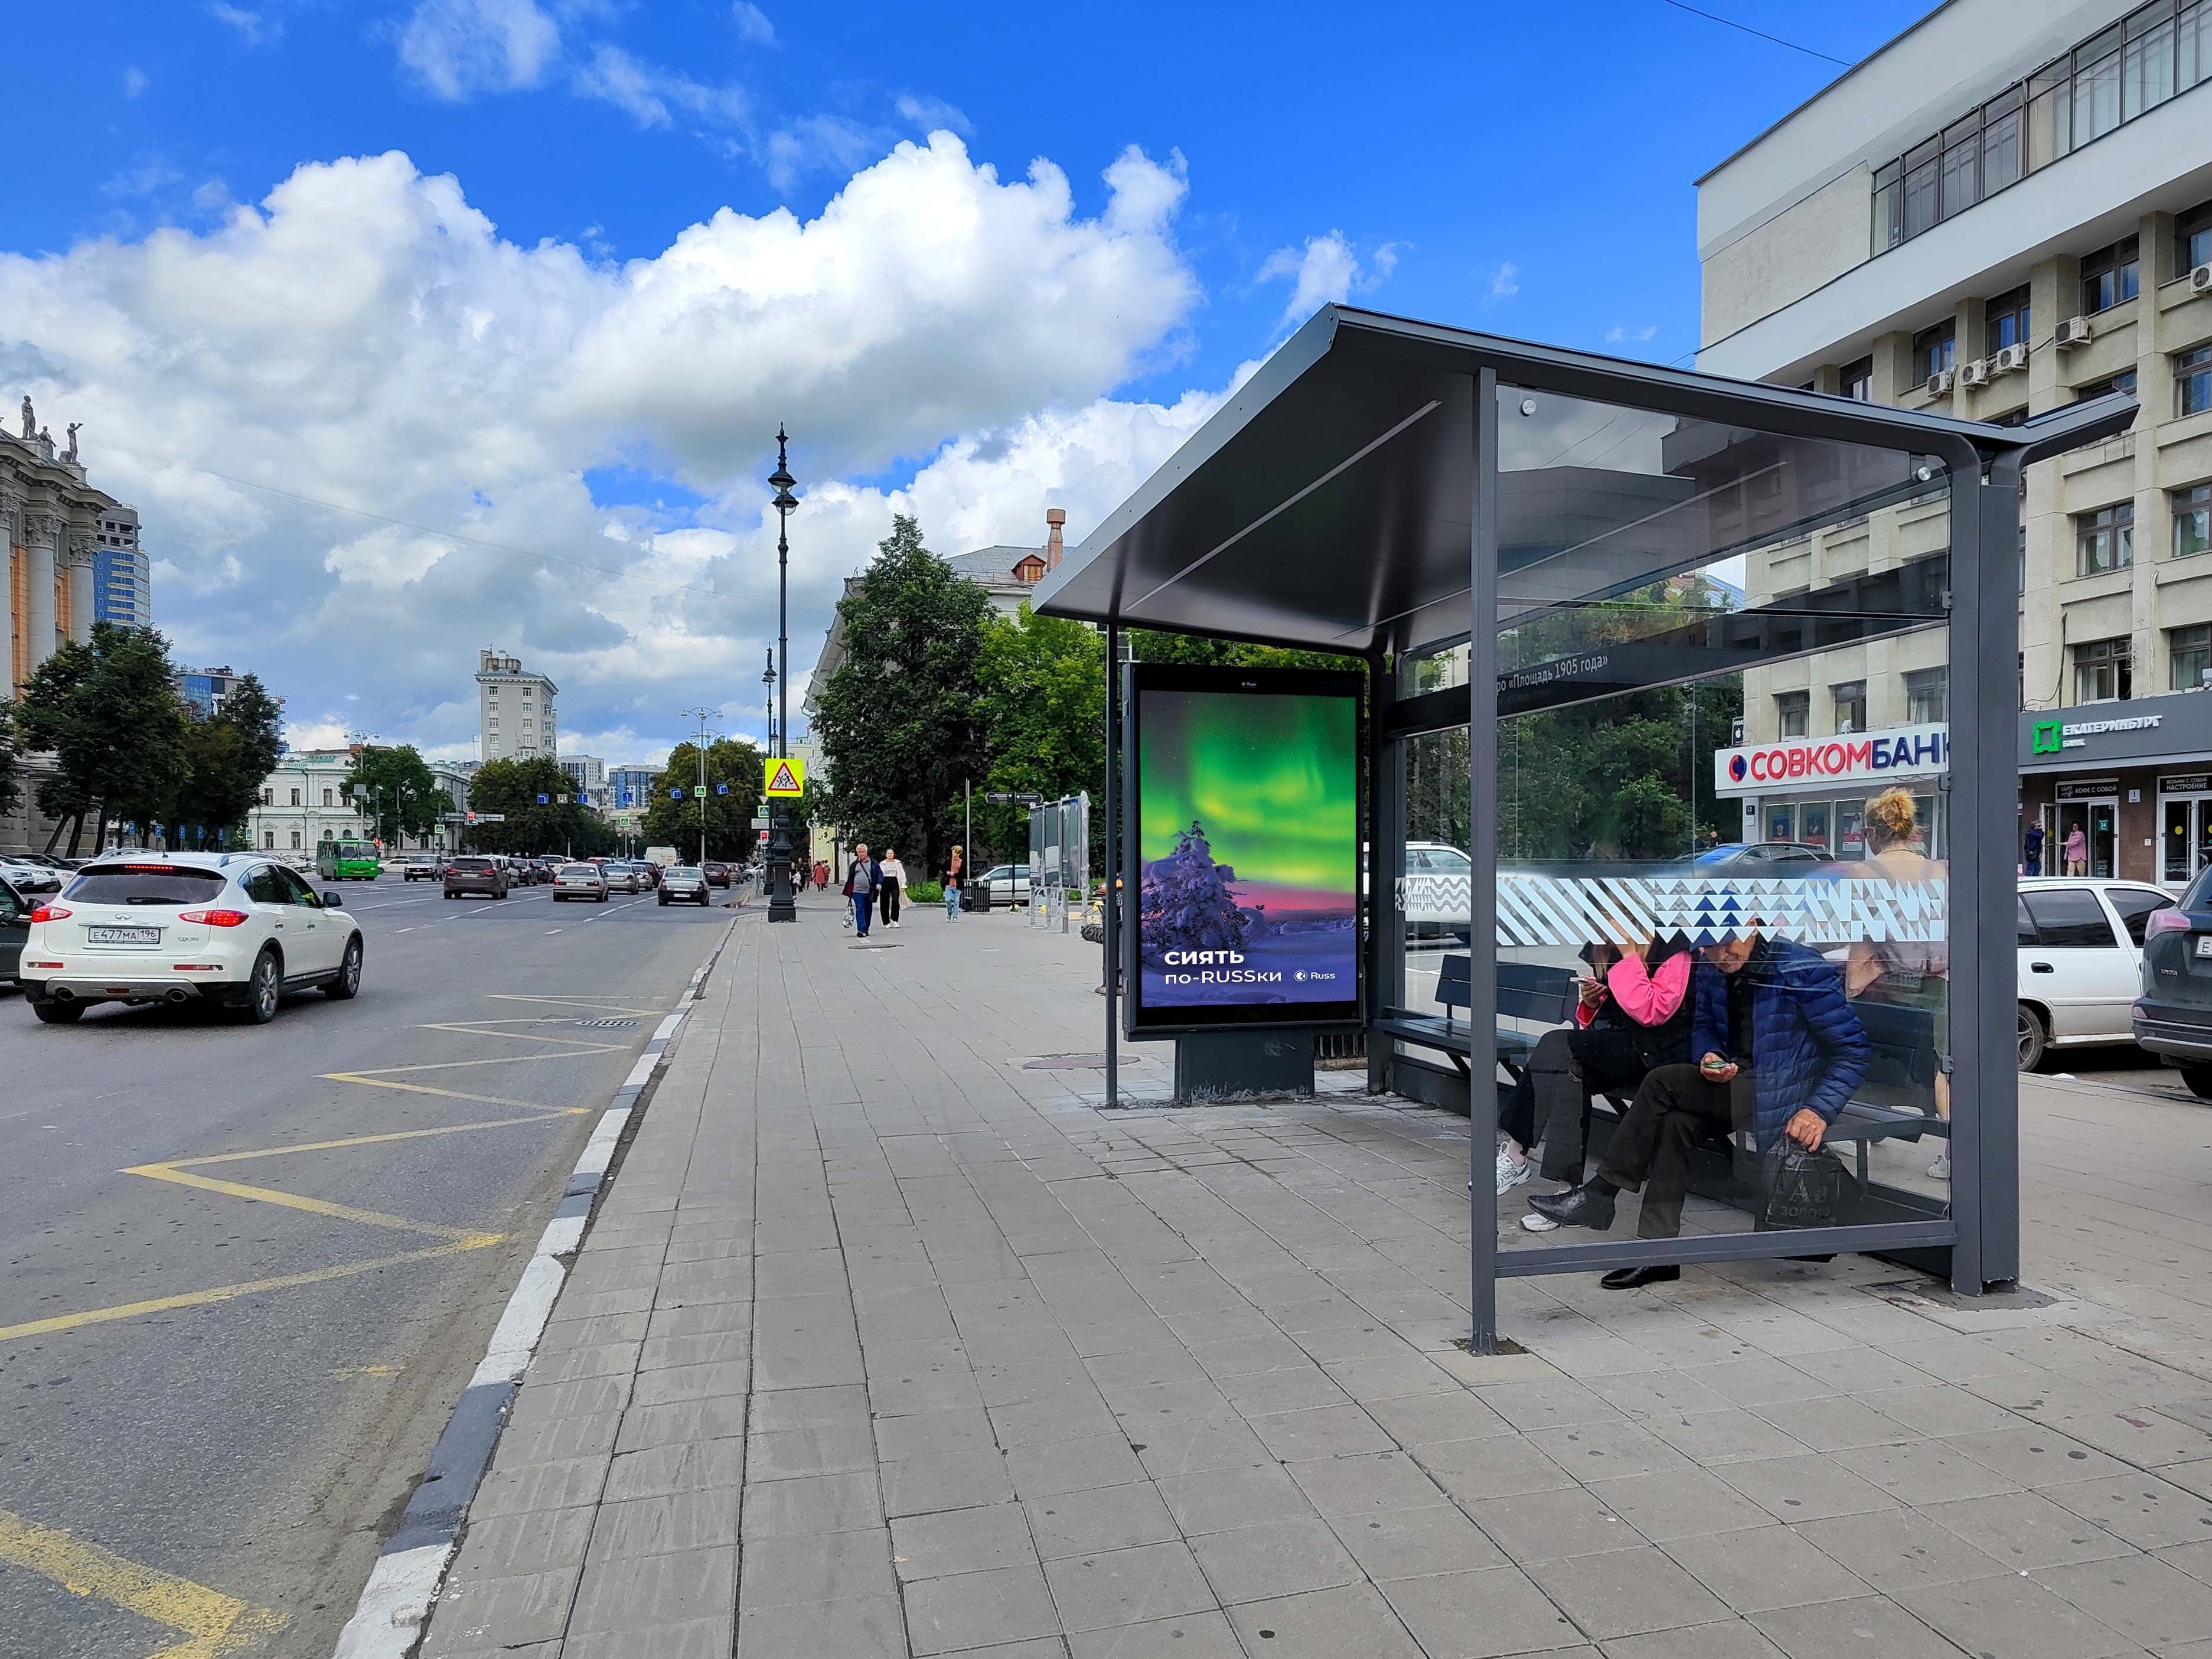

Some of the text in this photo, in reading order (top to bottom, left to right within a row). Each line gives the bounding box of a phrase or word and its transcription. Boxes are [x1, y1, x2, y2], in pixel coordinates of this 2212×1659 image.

[1497, 655, 1609, 693] ро «Площадь 1905 года»
[2063, 715, 2163, 736] ЕКАТЕРИНБУРГ
[2167, 783, 2207, 791] НАСТРОЕНИЕ
[93, 930, 136, 940] Е477МА
[1165, 970, 1281, 985] по-RUSSки
